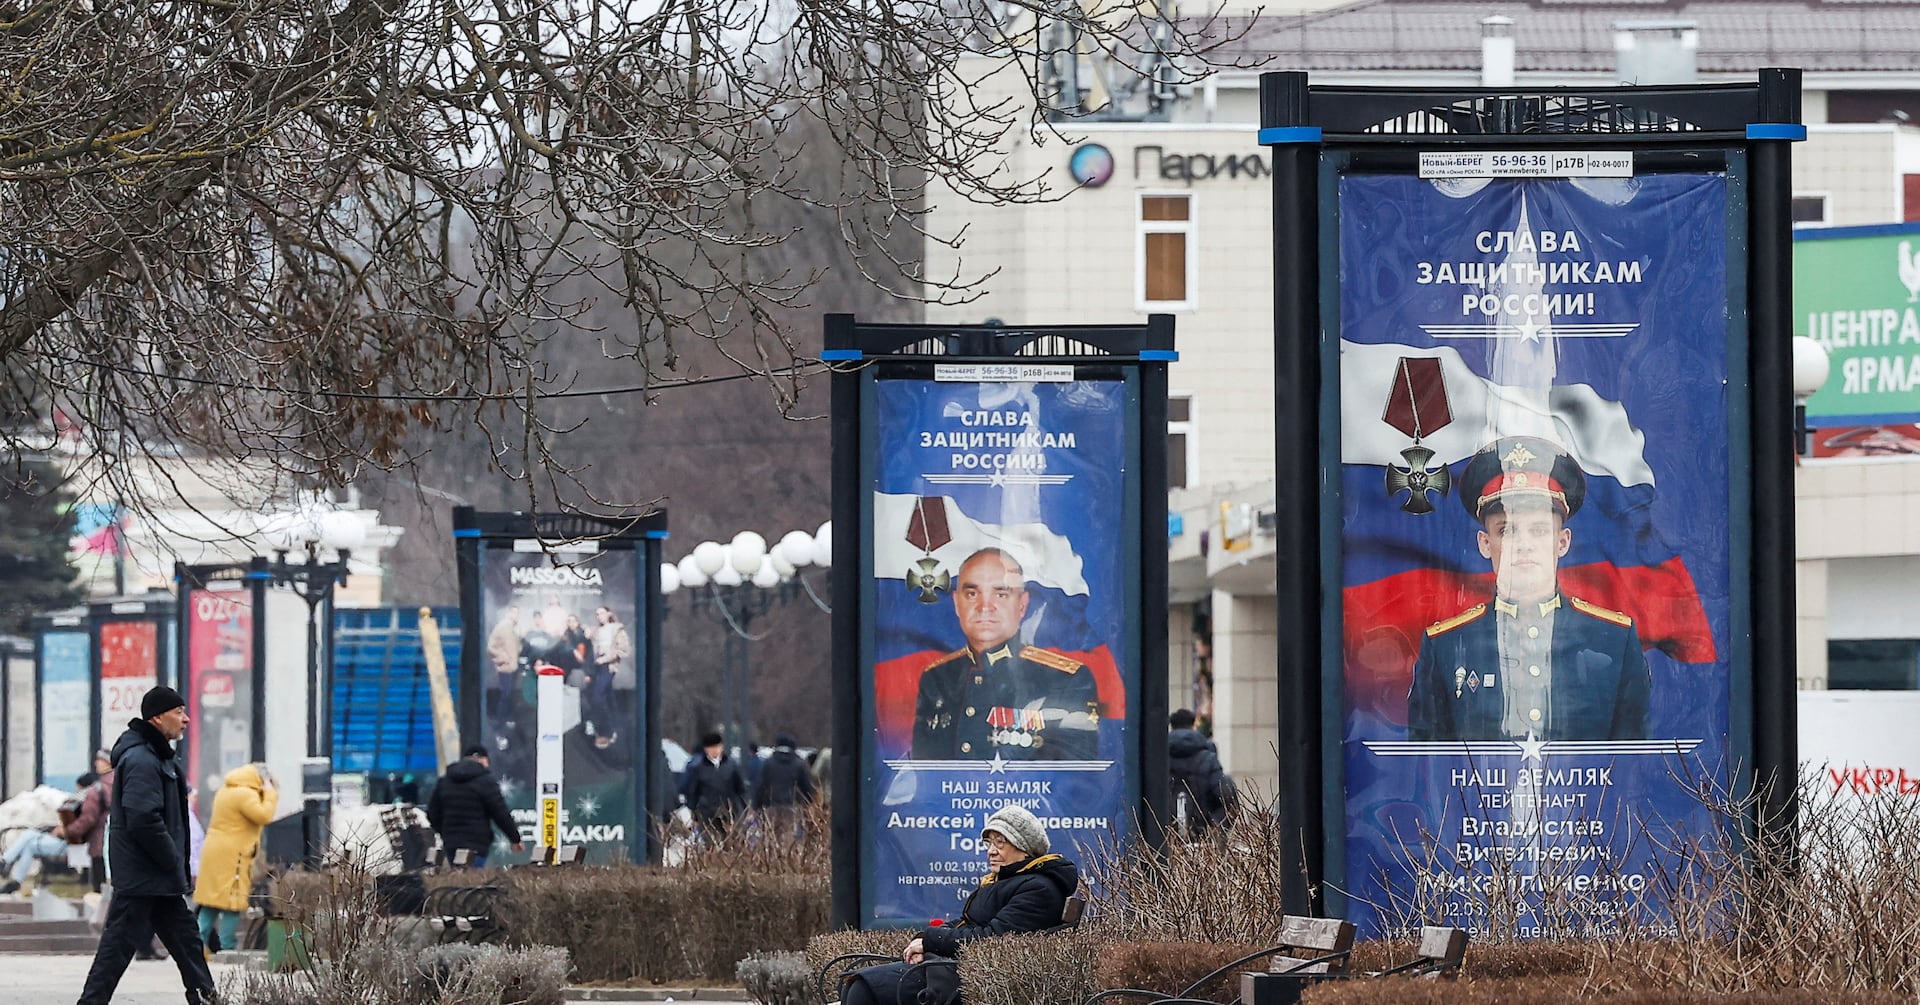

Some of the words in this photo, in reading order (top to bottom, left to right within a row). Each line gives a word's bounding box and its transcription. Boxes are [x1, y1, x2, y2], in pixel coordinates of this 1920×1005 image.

[1492, 155, 1546, 166] 56-96-36
[1475, 231, 1581, 254] СЛАВА
[1416, 261, 1643, 289] ЗАЩИТНИКАМ
[1462, 294, 1595, 316] РОССИИ!
[1808, 307, 1920, 352] ЦЕНТРА
[960, 411, 1034, 426] СЛАВА
[920, 432, 1076, 451] ЗАЩИТНИКАМ
[951, 453, 1046, 470] РОССИИ!
[1451, 768, 1506, 787] НАШ
[1517, 768, 1613, 787] ЗЕМЛЯК
[941, 781, 979, 794] НАШ
[986, 781, 1051, 794] ЗЕМЛЯК
[952, 798, 1041, 810] ПОЛКОВНИК
[1478, 789, 1587, 808] ЛЕЙТЕНАНТ
[887, 812, 975, 829] Алексей
[984, 813, 1108, 829] лаевич
[1462, 817, 1604, 838] Владислав
[1456, 843, 1611, 863] Витальевич
[898, 876, 967, 887] награжден
